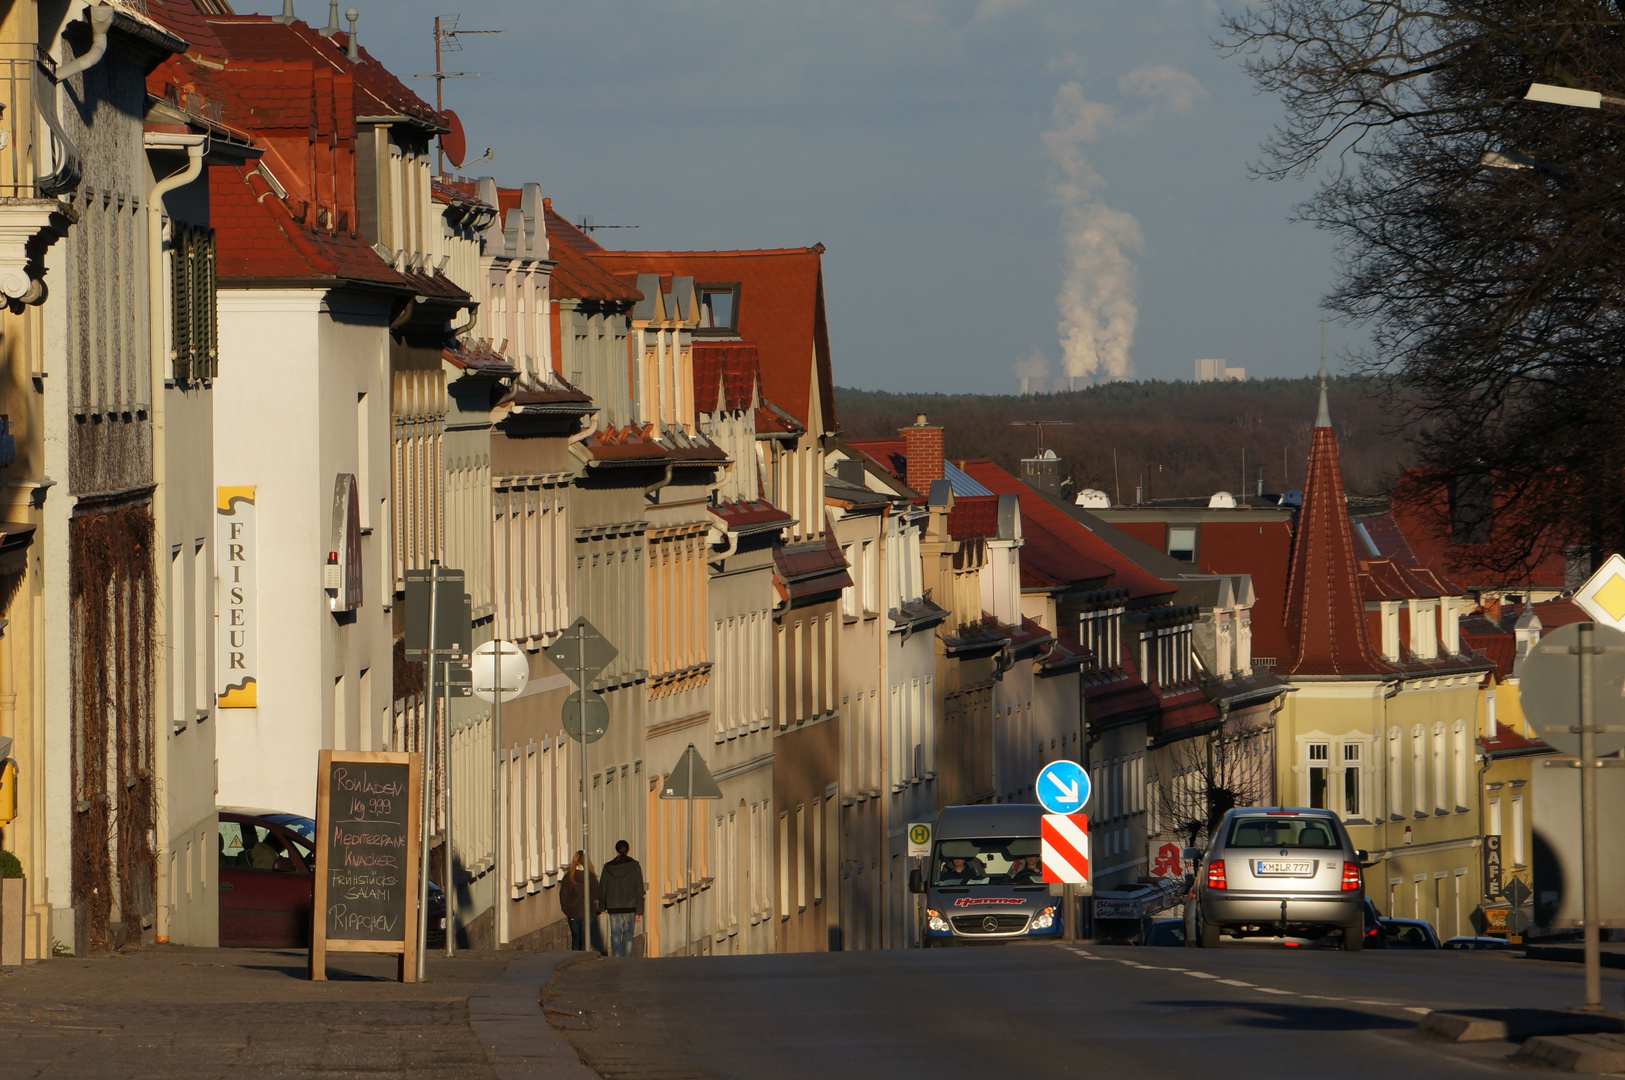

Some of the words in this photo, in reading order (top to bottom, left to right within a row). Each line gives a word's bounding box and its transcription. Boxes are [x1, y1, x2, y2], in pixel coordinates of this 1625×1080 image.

[228, 522, 247, 670] FRISEUR
[915, 829, 925, 840] H
[1263, 863, 1275, 872] KM
[1280, 863, 1291, 872] LR
[1293, 863, 1310, 872] 777
[1487, 836, 1500, 895] CAFÉ
[344, 886, 390, 902] SALAMI
[954, 896, 1027, 907] Hammer
[328, 903, 398, 932] RIPPCHEN
